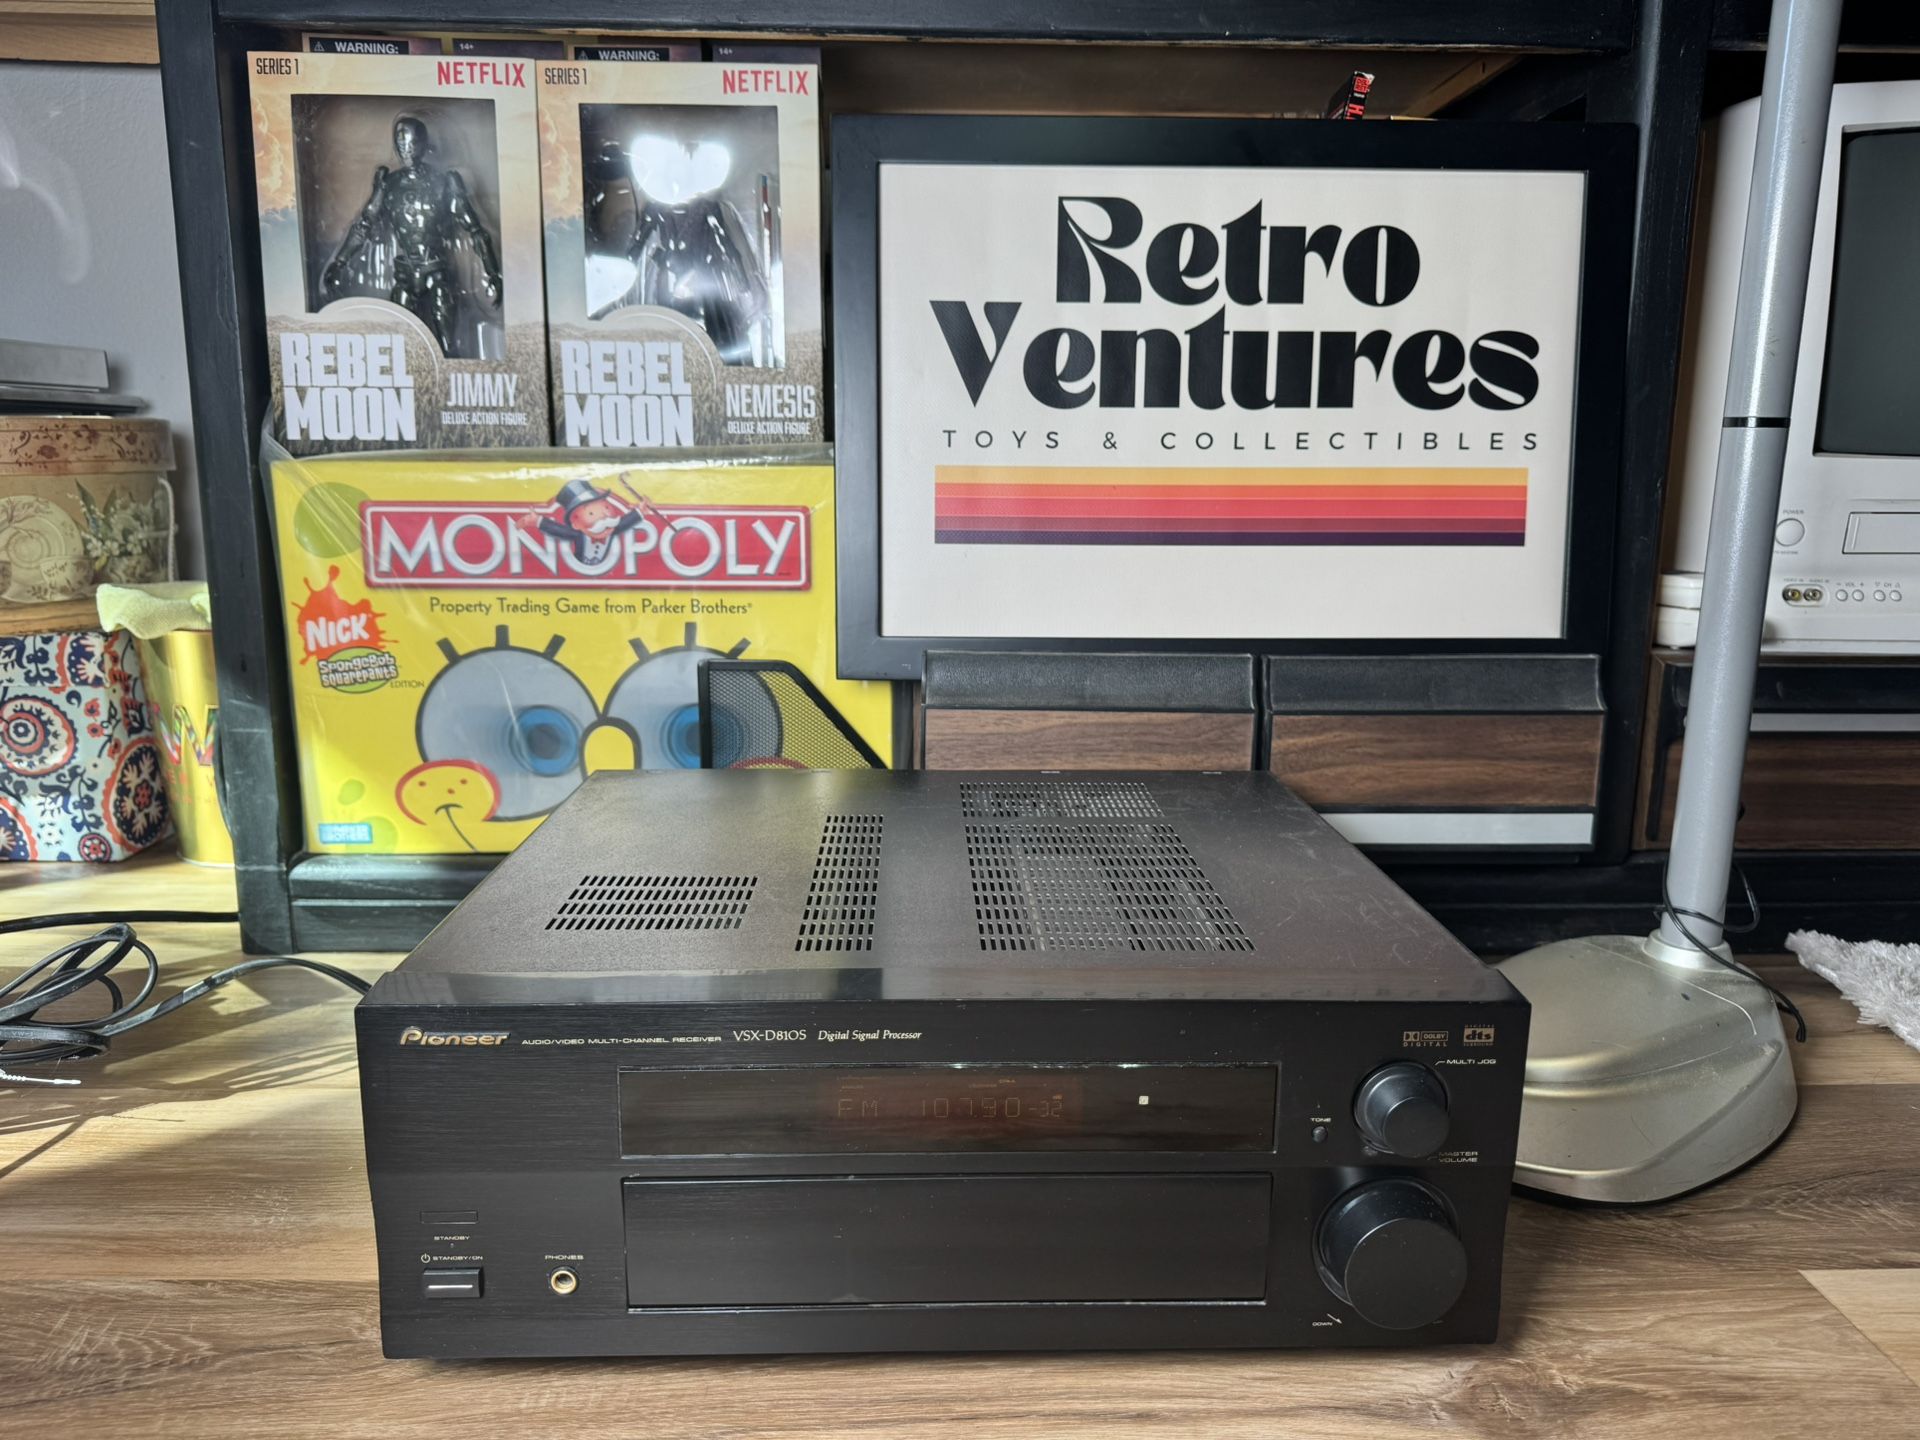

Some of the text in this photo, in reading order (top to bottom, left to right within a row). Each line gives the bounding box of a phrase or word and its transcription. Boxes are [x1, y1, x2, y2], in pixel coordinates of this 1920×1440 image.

[334, 41, 399, 54] WARNING:
[459, 42, 474, 50] 14+
[598, 50, 660, 61] WARNING:
[256, 58, 300, 75] SERIES 1
[437, 61, 526, 88] NETFLIX
[544, 68, 588, 85] SERIES 1
[722, 70, 809, 95] NETFLIX
[1056, 196, 1420, 307] Retro
[280, 332, 414, 387] REBEL
[929, 299, 1540, 411] Ventures
[560, 341, 692, 395] REBEL
[447, 373, 518, 407] JIMMY
[725, 383, 816, 418] NEMESIS
[284, 386, 417, 441] MOON
[442, 411, 528, 426] DELUXE ACTION FIGURE
[564, 395, 695, 447] MOON
[727, 421, 811, 435] DELUXE ACTION FIGURE
[942, 429, 1537, 451] TOYS & COLLECTIBLES
[376, 514, 797, 577] MONOPOLY
[430, 597, 491, 615] Property
[496, 597, 550, 616] Trading
[555, 597, 600, 613] Game
[605, 598, 636, 614] from
[641, 598, 686, 614] Parker
[390, 680, 425, 689] EDITION
[400, 1026, 510, 1046] Pioneer
[733, 1029, 807, 1042] VSX-D810S
[817, 1029, 922, 1042] Digital Signal Processor
[1465, 1029, 1492, 1040] dts
[837, 1098, 879, 1118] FM
